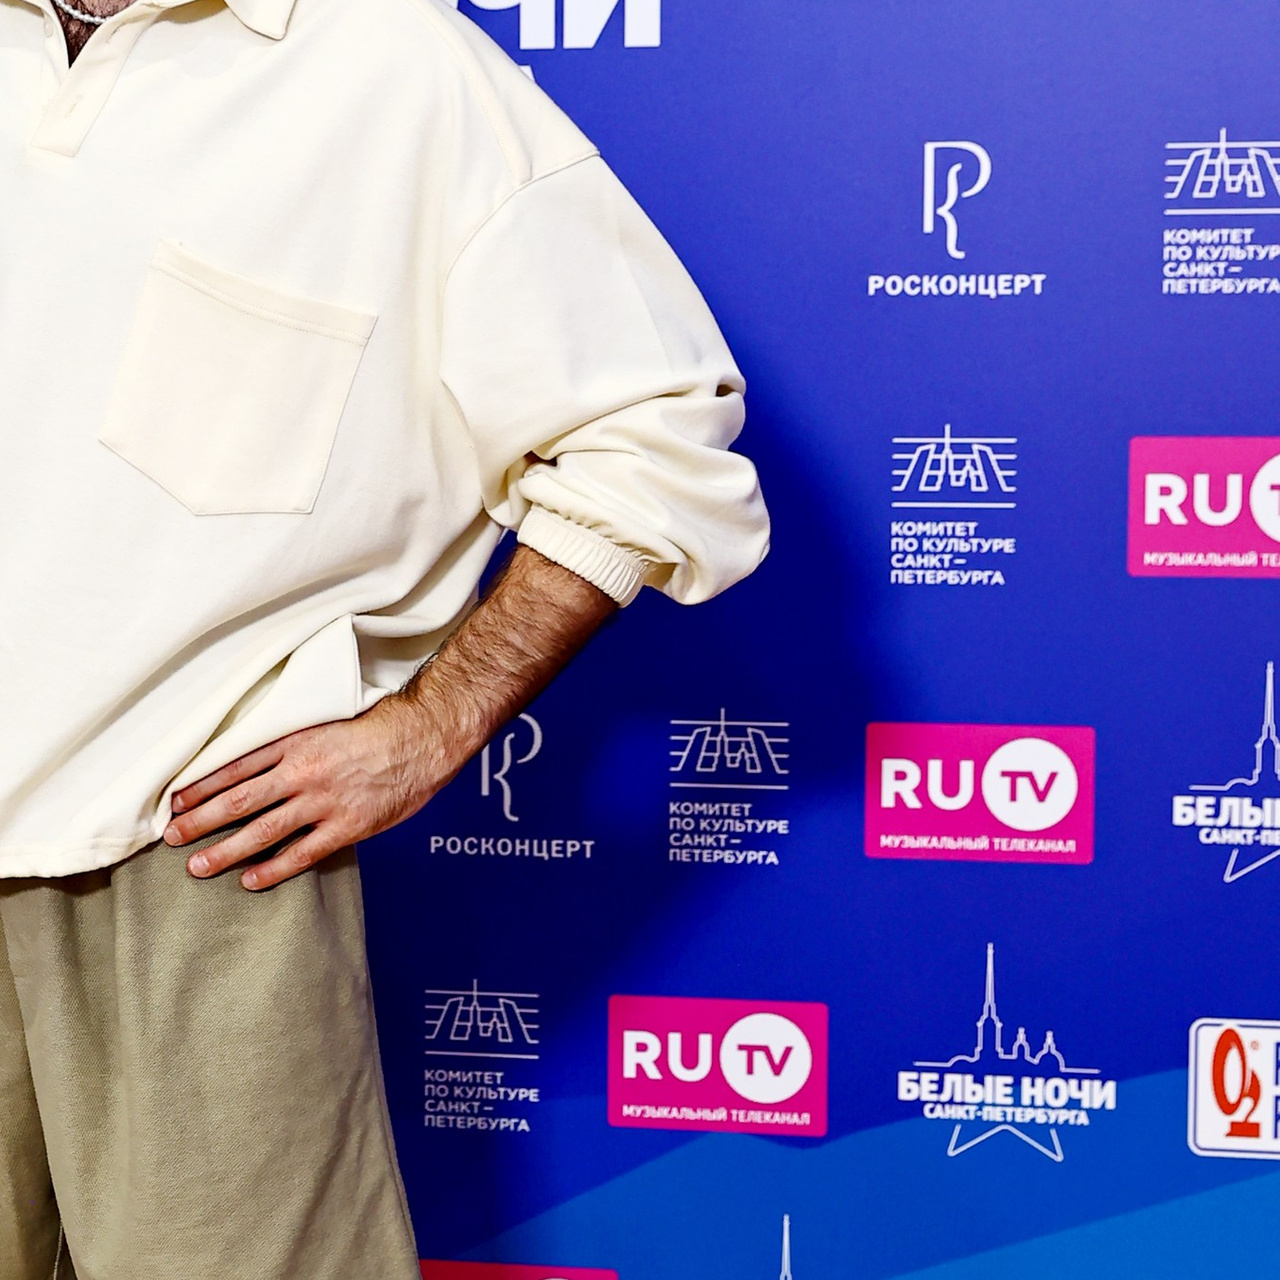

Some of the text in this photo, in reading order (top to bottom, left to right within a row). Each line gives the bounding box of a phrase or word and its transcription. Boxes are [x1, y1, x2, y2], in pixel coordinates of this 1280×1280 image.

[868, 274, 1046, 299] РОСКОНЦЕРТ
[1144, 472, 1243, 527] RU
[891, 522, 977, 537] КОМИТЕТ
[891, 537, 1015, 555] ПО КУЛЬТУРЕ
[890, 568, 1004, 586] ПЕТЕРБУРГА
[881, 758, 1058, 811] RU TV
[1172, 795, 1280, 828] БЕЛЫ
[429, 834, 595, 861] РОСКОНЦЕРТ
[623, 1030, 793, 1083] RU TV
[899, 1071, 1116, 1109] БЕЛЫЕ НОЧИ
